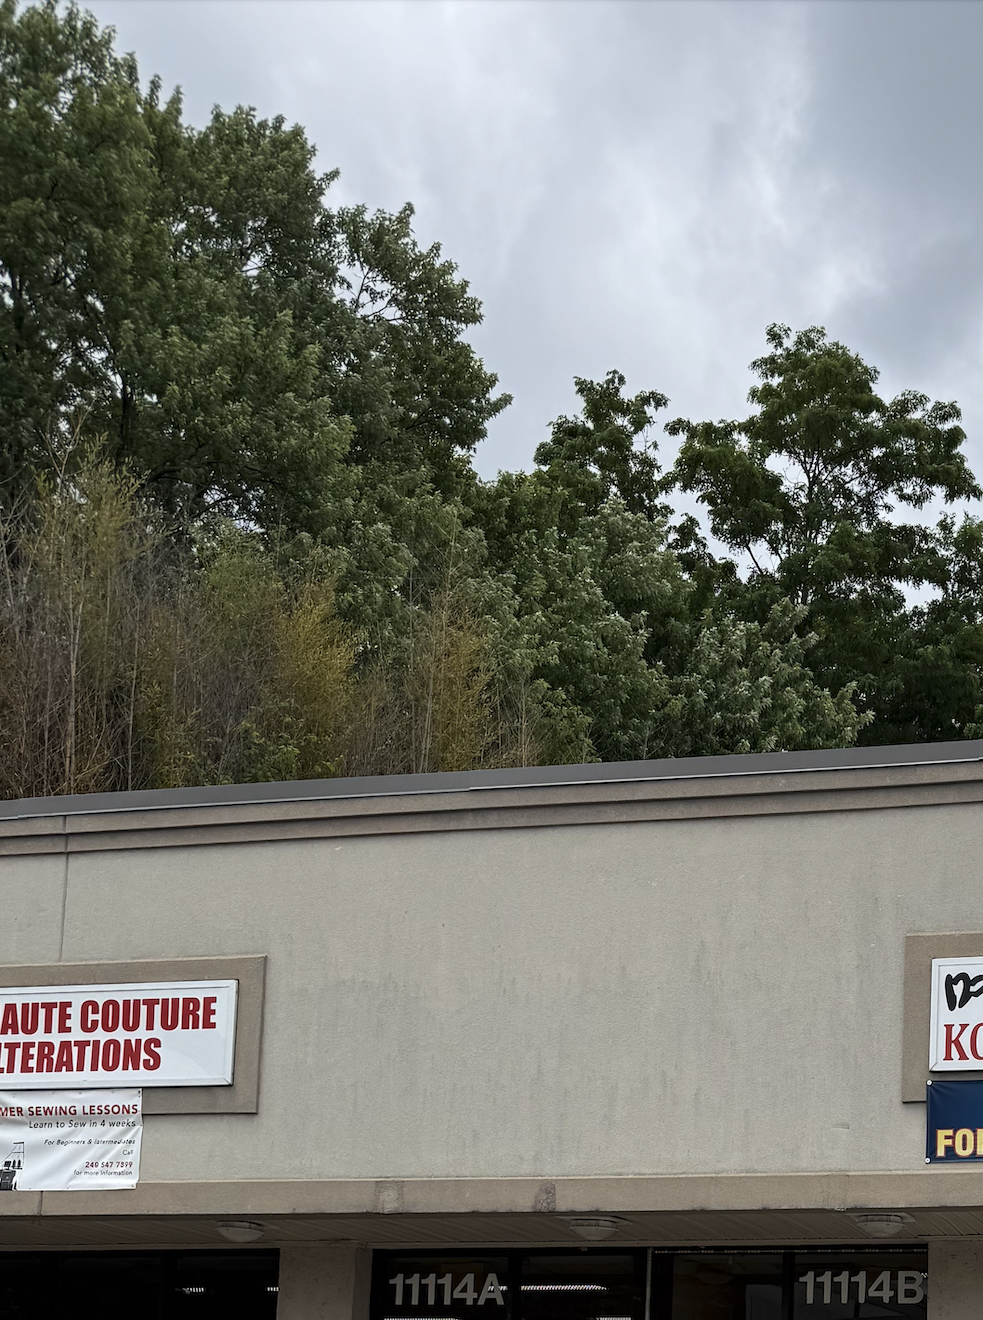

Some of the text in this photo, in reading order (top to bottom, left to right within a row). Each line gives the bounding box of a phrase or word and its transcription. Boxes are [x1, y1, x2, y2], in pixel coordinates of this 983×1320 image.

[80, 996, 218, 1033] COUTURE
[28, 1105, 77, 1116] SEWING
[82, 1104, 138, 1115] LESSONS
[29, 1118, 136, 1129] Learn to Sew in 4 weeks
[388, 1273, 505, 1306] 11114A
[799, 1270, 925, 1305] 11114B
